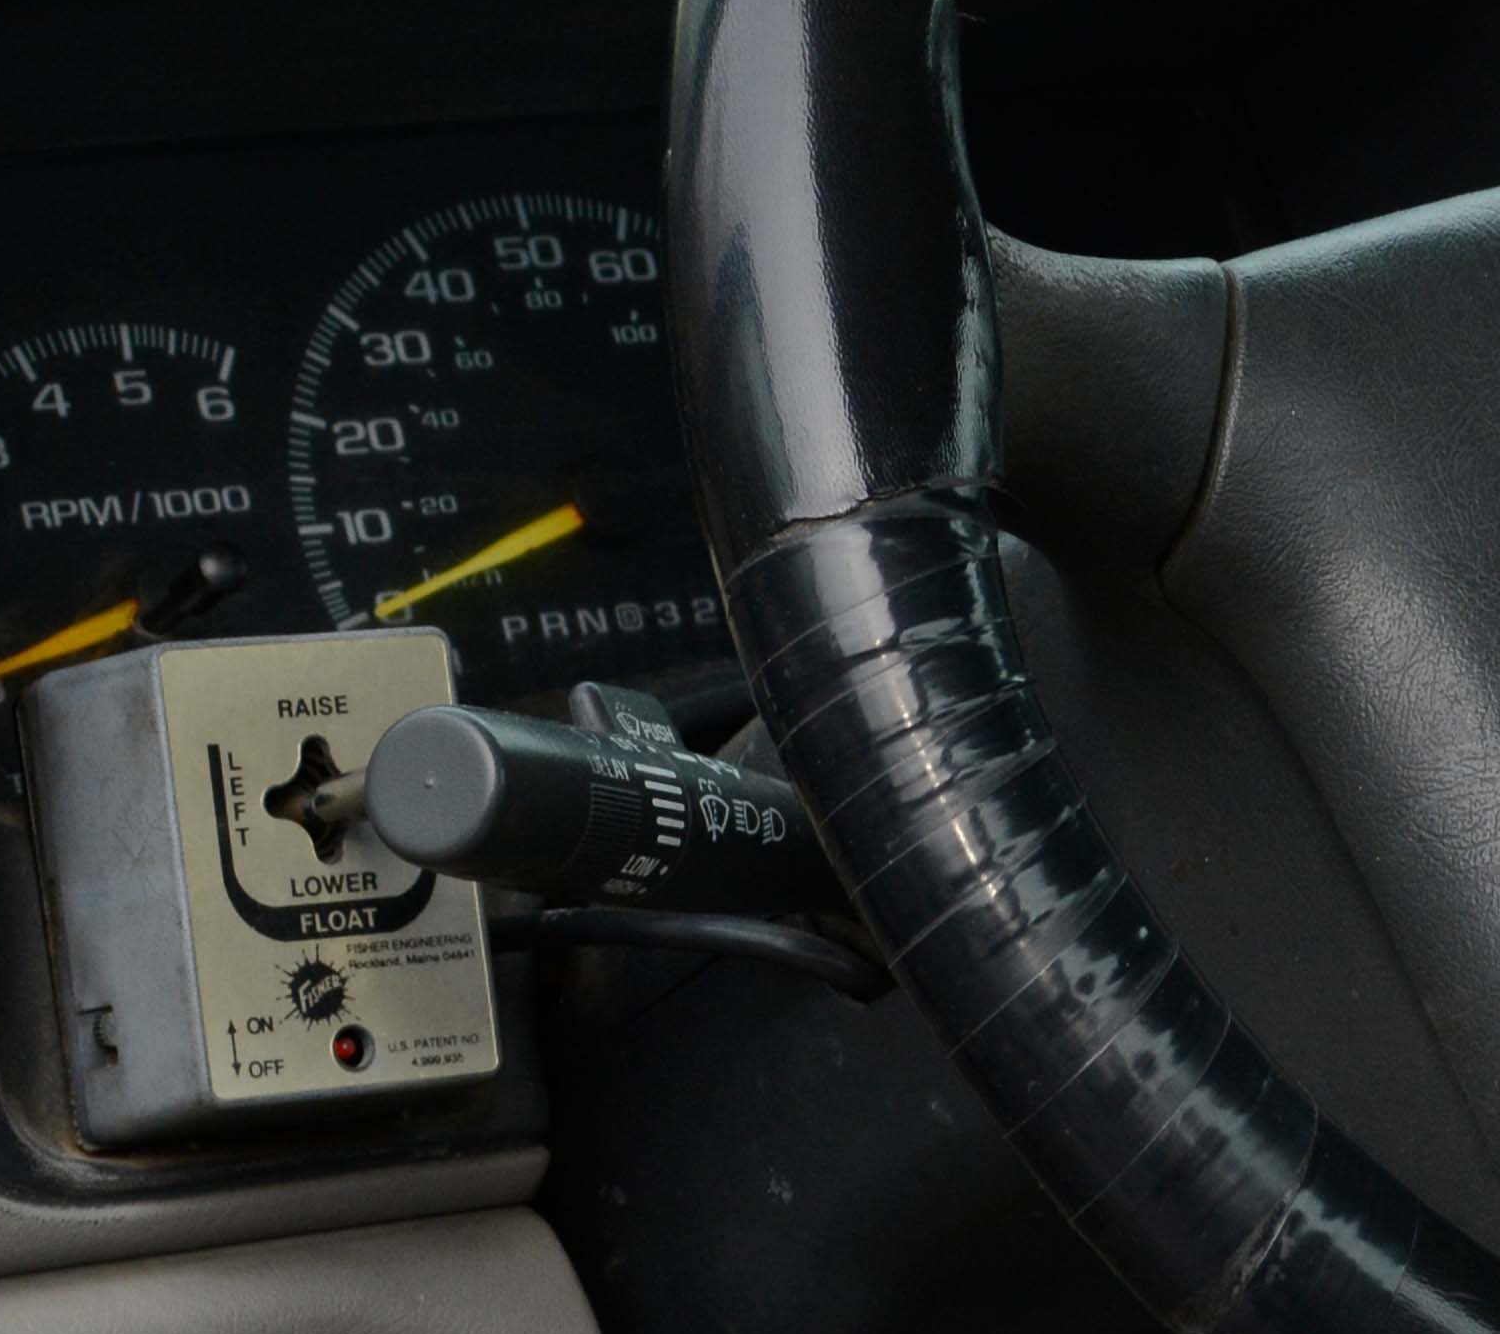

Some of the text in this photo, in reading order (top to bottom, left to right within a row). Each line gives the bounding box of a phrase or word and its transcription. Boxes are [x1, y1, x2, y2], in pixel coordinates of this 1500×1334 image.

[493, 234, 564, 272] 50
[589, 248, 658, 284] 60
[404, 268, 476, 305] 40
[360, 329, 431, 367] 30
[611, 323, 658, 346] 100
[32, 382, 71, 419] 4
[113, 369, 153, 406] 5
[197, 385, 236, 422] 6
[421, 409, 460, 429] 40
[332, 418, 405, 456] 20
[420, 495, 459, 515] 20
[336, 507, 392, 545] 10
[277, 695, 349, 719] RAISE
[640, 720, 677, 745] PUSH
[586, 755, 630, 782] DELAY
[228, 751, 250, 848] LEFT
[621, 854, 661, 877] LOW
[290, 871, 379, 898] LOWER
[300, 908, 378, 935] FLOAT
[246, 1015, 274, 1035] ON
[413, 1034, 459, 1049] PATENT
[249, 1059, 284, 1079] OFF
